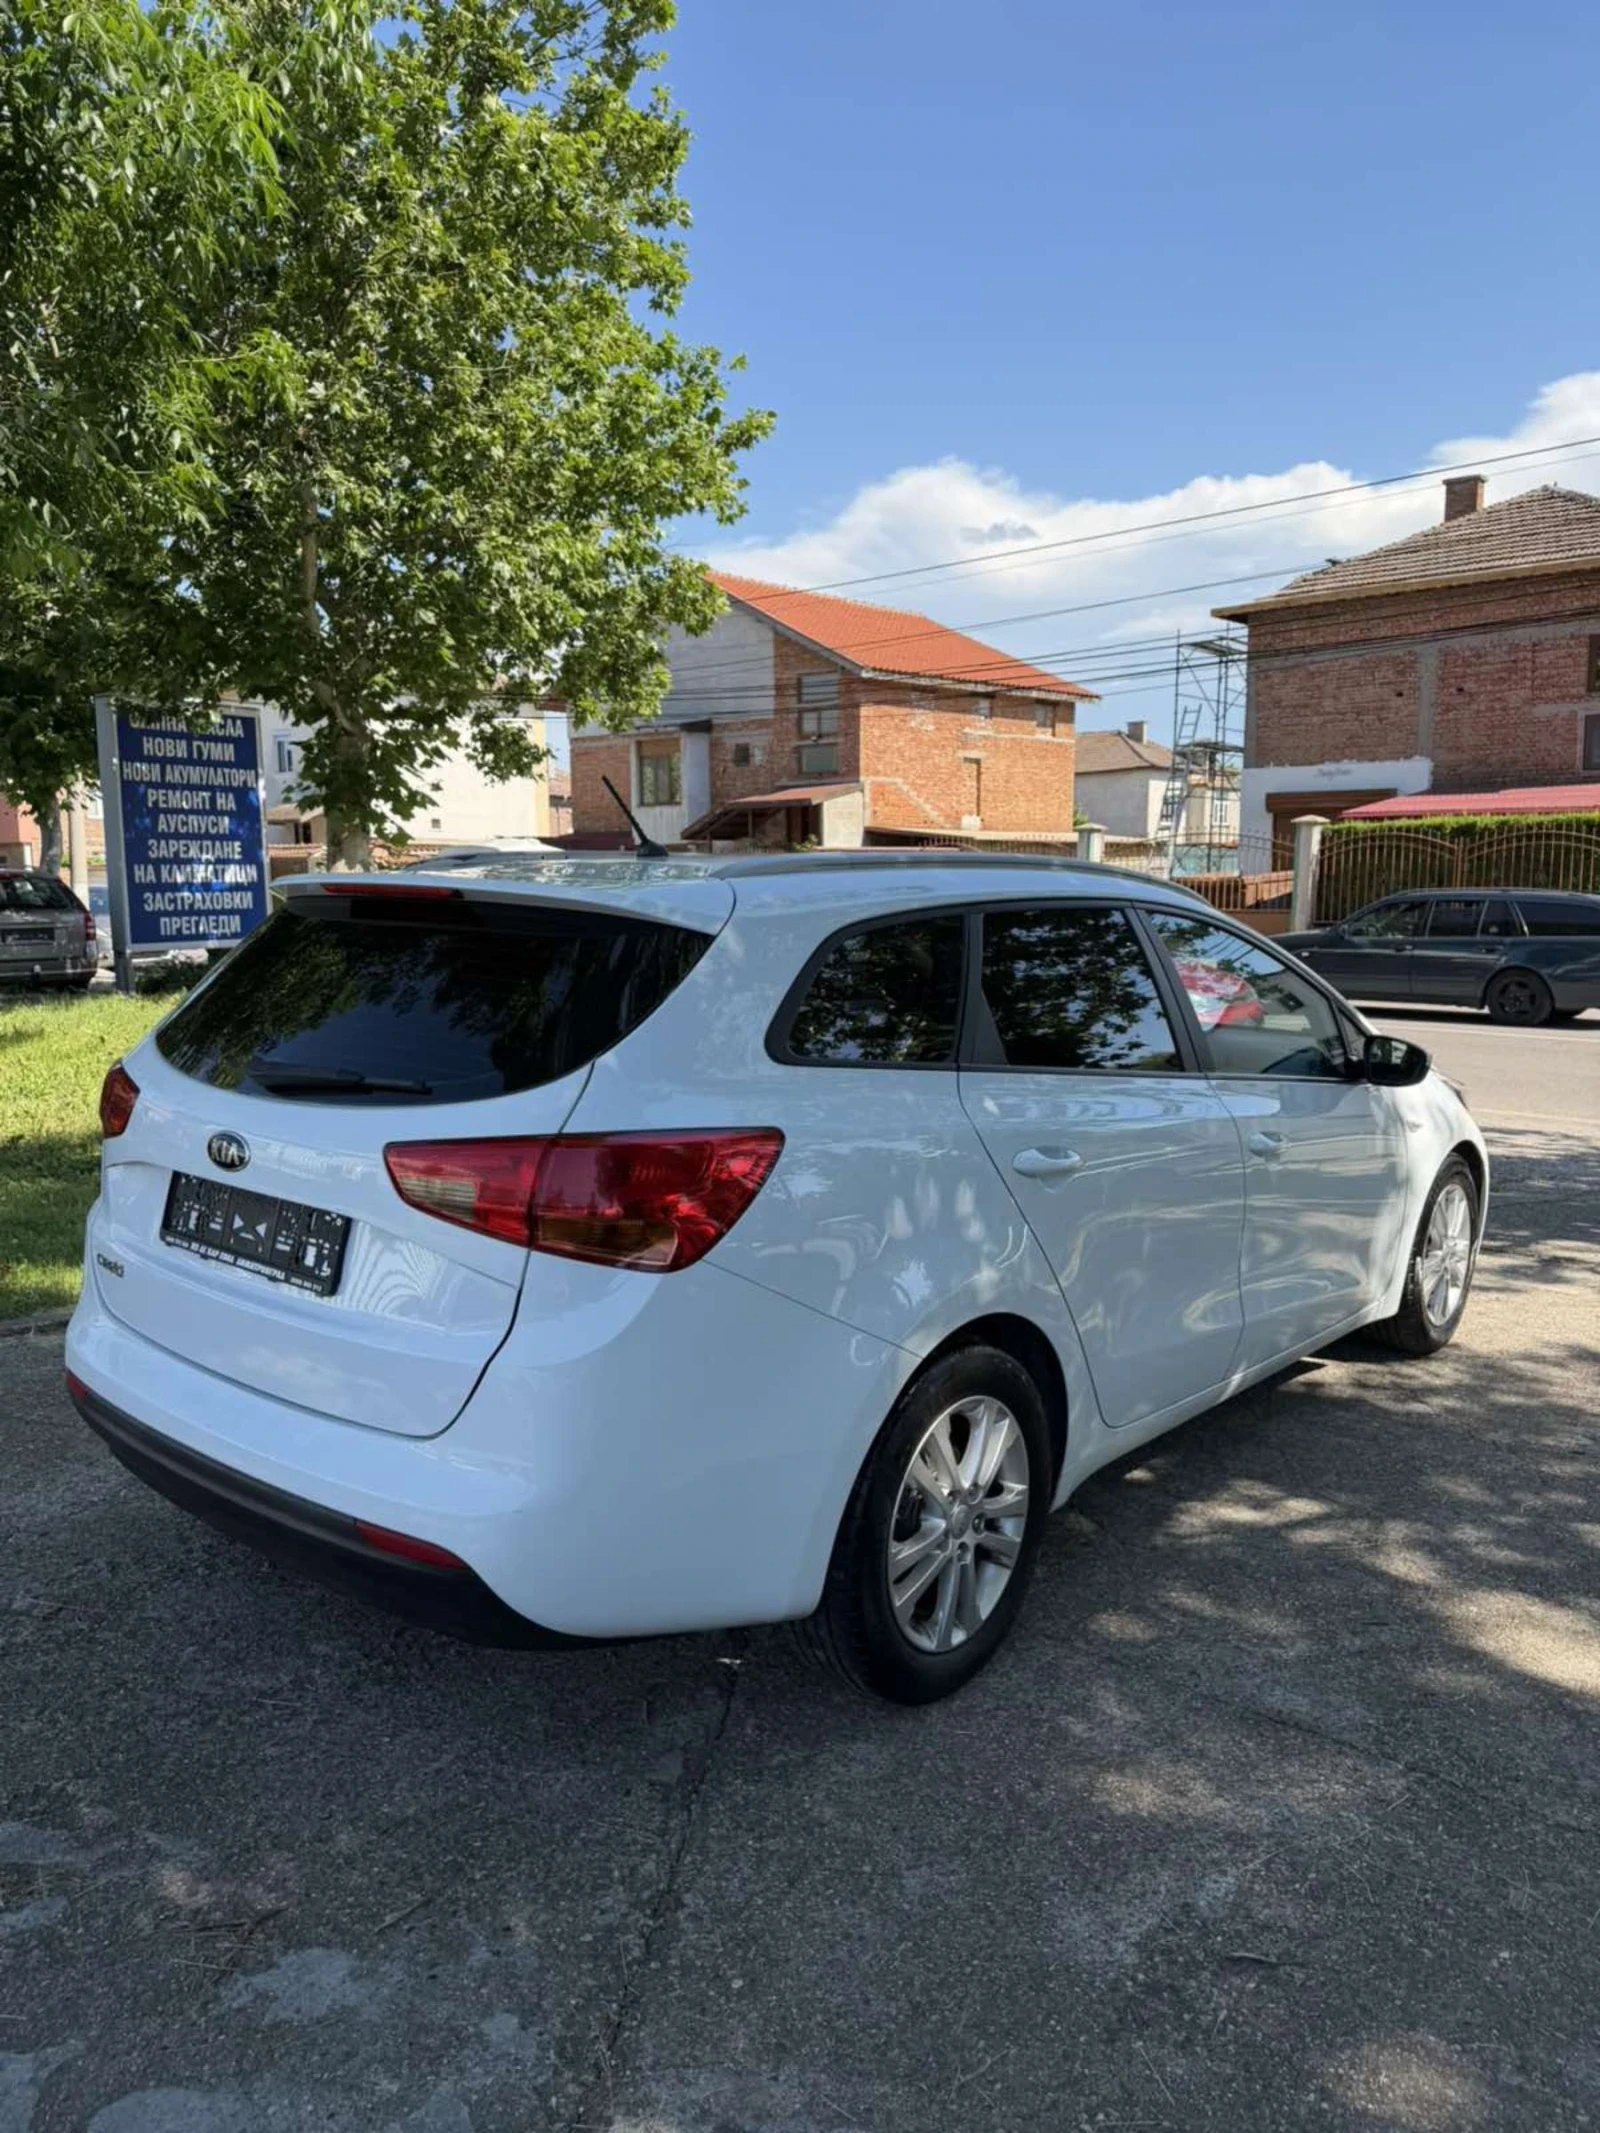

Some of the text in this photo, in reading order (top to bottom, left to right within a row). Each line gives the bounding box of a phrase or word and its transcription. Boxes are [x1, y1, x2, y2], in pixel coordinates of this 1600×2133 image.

[192, 716, 245, 738] АСЛА
[143, 735, 235, 762] НОВИ ГУМИ
[122, 761, 257, 788] НОВИ АКУМУЛАТОРИ
[147, 788, 236, 812] РЕМОНТ НА
[158, 813, 230, 835] АУСПУСИ
[147, 839, 243, 862] ЗАРЕЖДАНЕ
[133, 863, 258, 886] НА КЛИМАТИЦИ
[143, 891, 254, 912] ЗАСТРАХОВКИ
[160, 914, 242, 937] ПРЕГЛЕДИ
[209, 1136, 247, 1168] KIA
